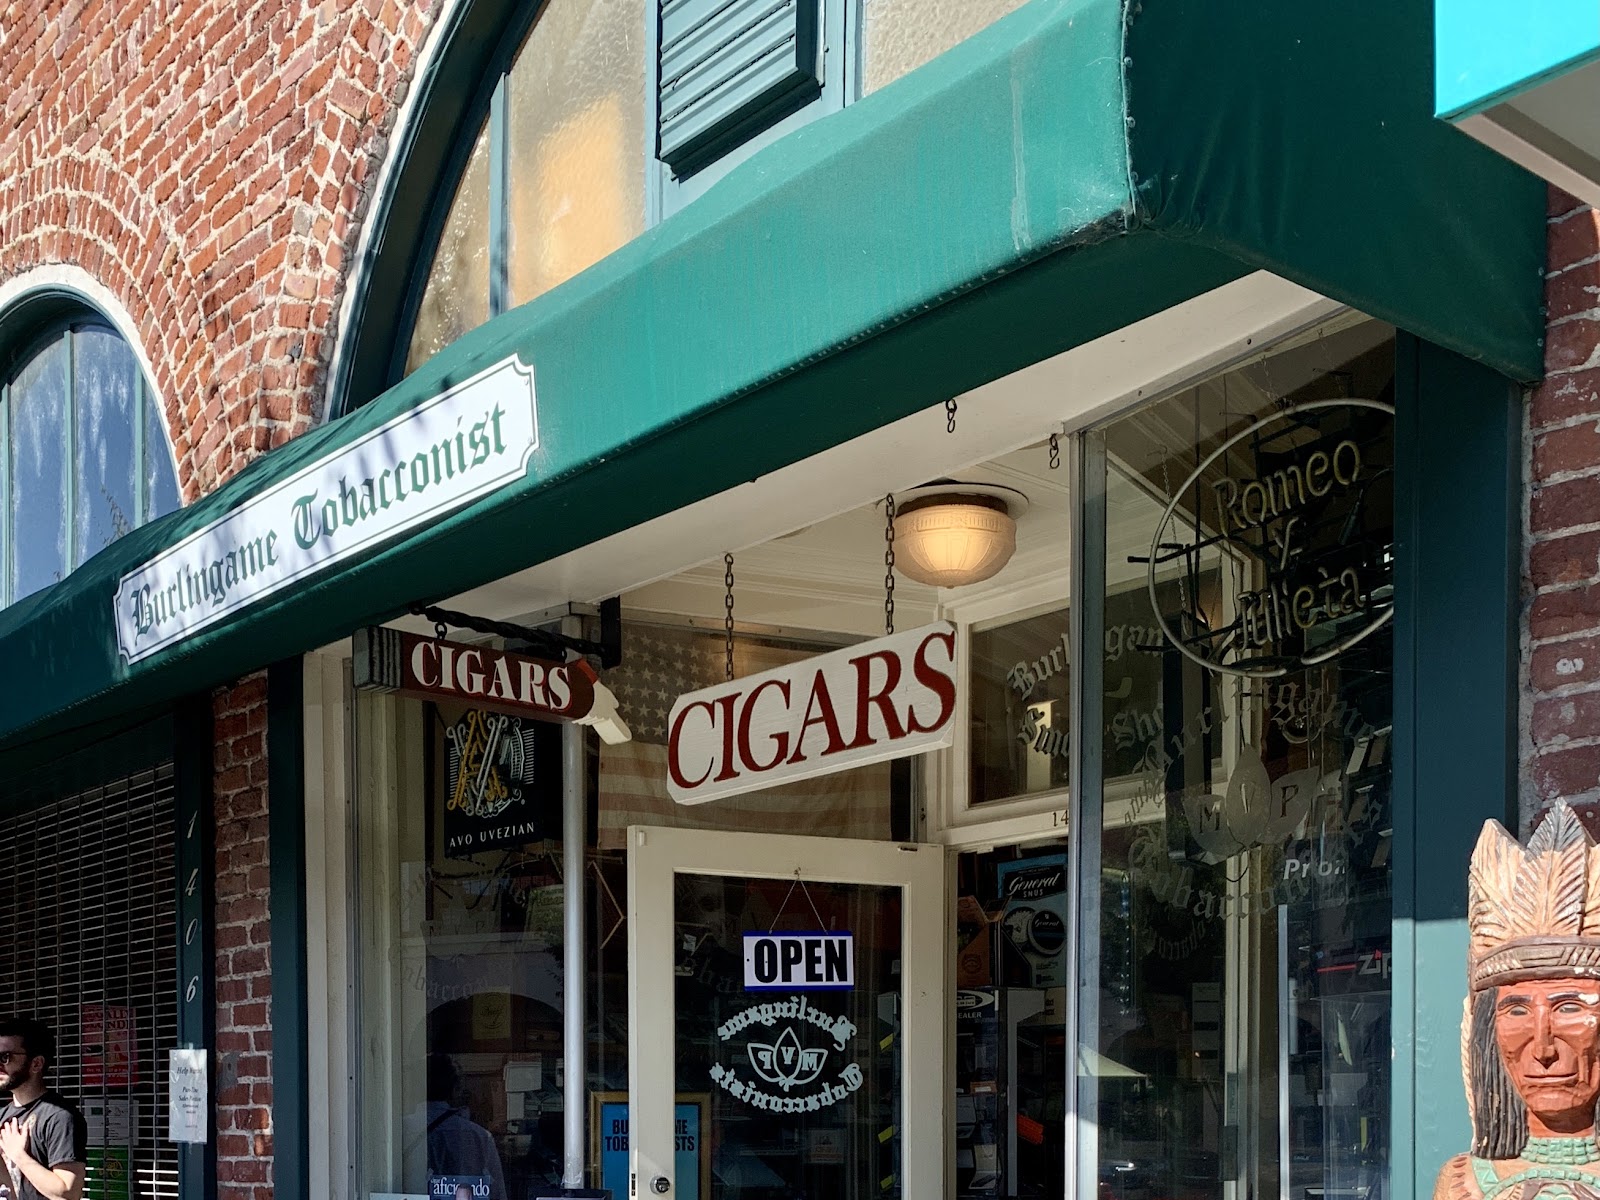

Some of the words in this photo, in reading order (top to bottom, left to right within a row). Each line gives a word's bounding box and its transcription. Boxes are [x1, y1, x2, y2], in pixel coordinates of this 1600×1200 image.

[1211, 439, 1361, 537] Romeo
[131, 528, 280, 636] Burlingame
[292, 400, 509, 550] Tobacconist
[411, 640, 571, 711] CIGARS
[668, 630, 957, 789] CIGARS
[449, 833, 474, 848] AVO
[479, 821, 536, 843] UVEZIAN
[1006, 872, 1061, 897] General
[1023, 889, 1044, 898] SNUS
[753, 937, 850, 984] OPEN
